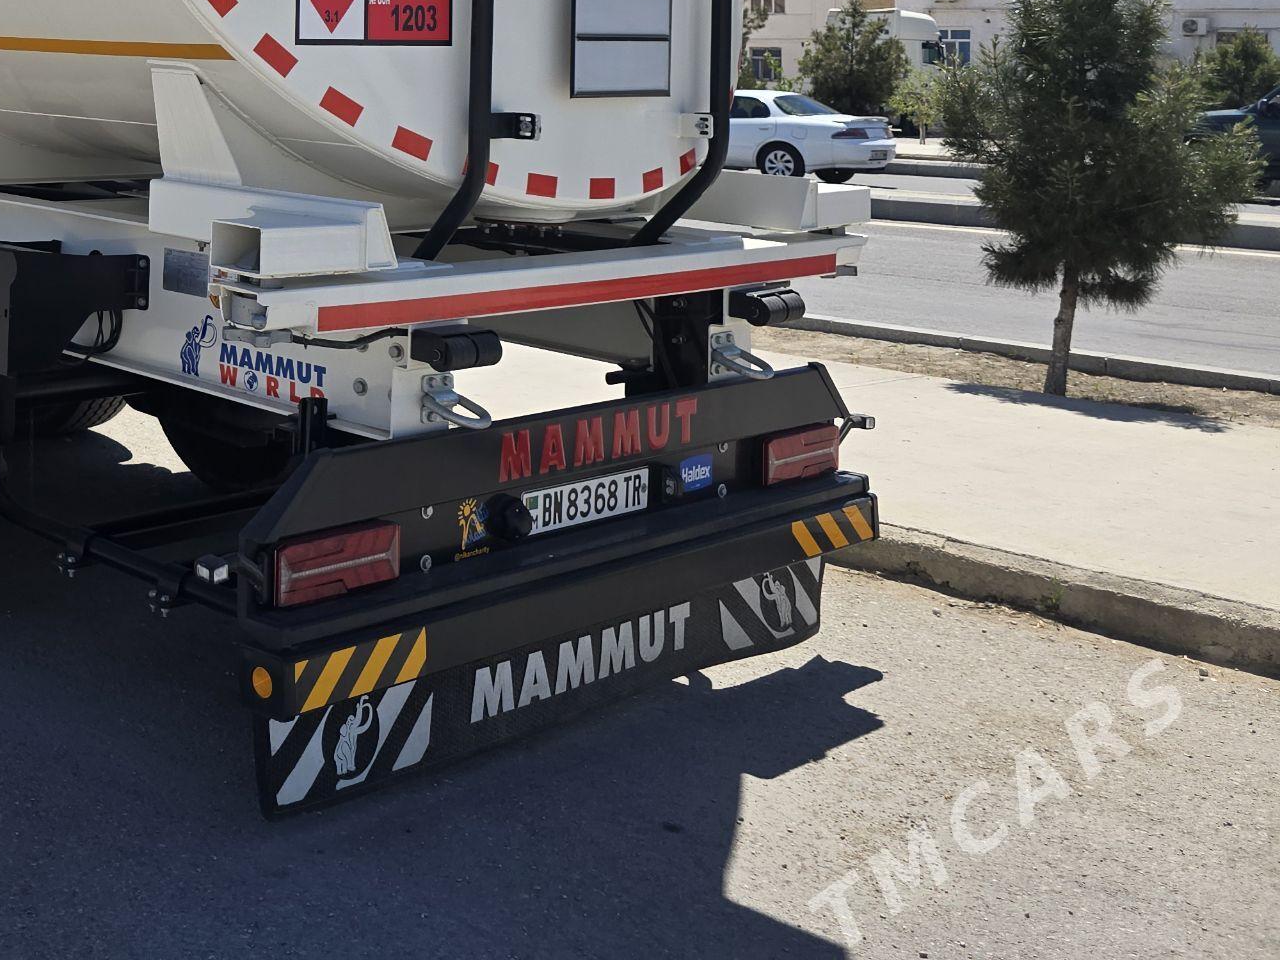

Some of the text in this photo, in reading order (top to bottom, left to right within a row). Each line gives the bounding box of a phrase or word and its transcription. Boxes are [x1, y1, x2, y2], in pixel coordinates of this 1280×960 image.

[324, 9, 339, 23] 3.1
[390, 4, 438, 32] 1203
[220, 342, 327, 387] MAMMUT
[498, 396, 699, 483] MAMMUT
[681, 464, 711, 484] Haldex
[470, 601, 691, 724] MAMMUT
